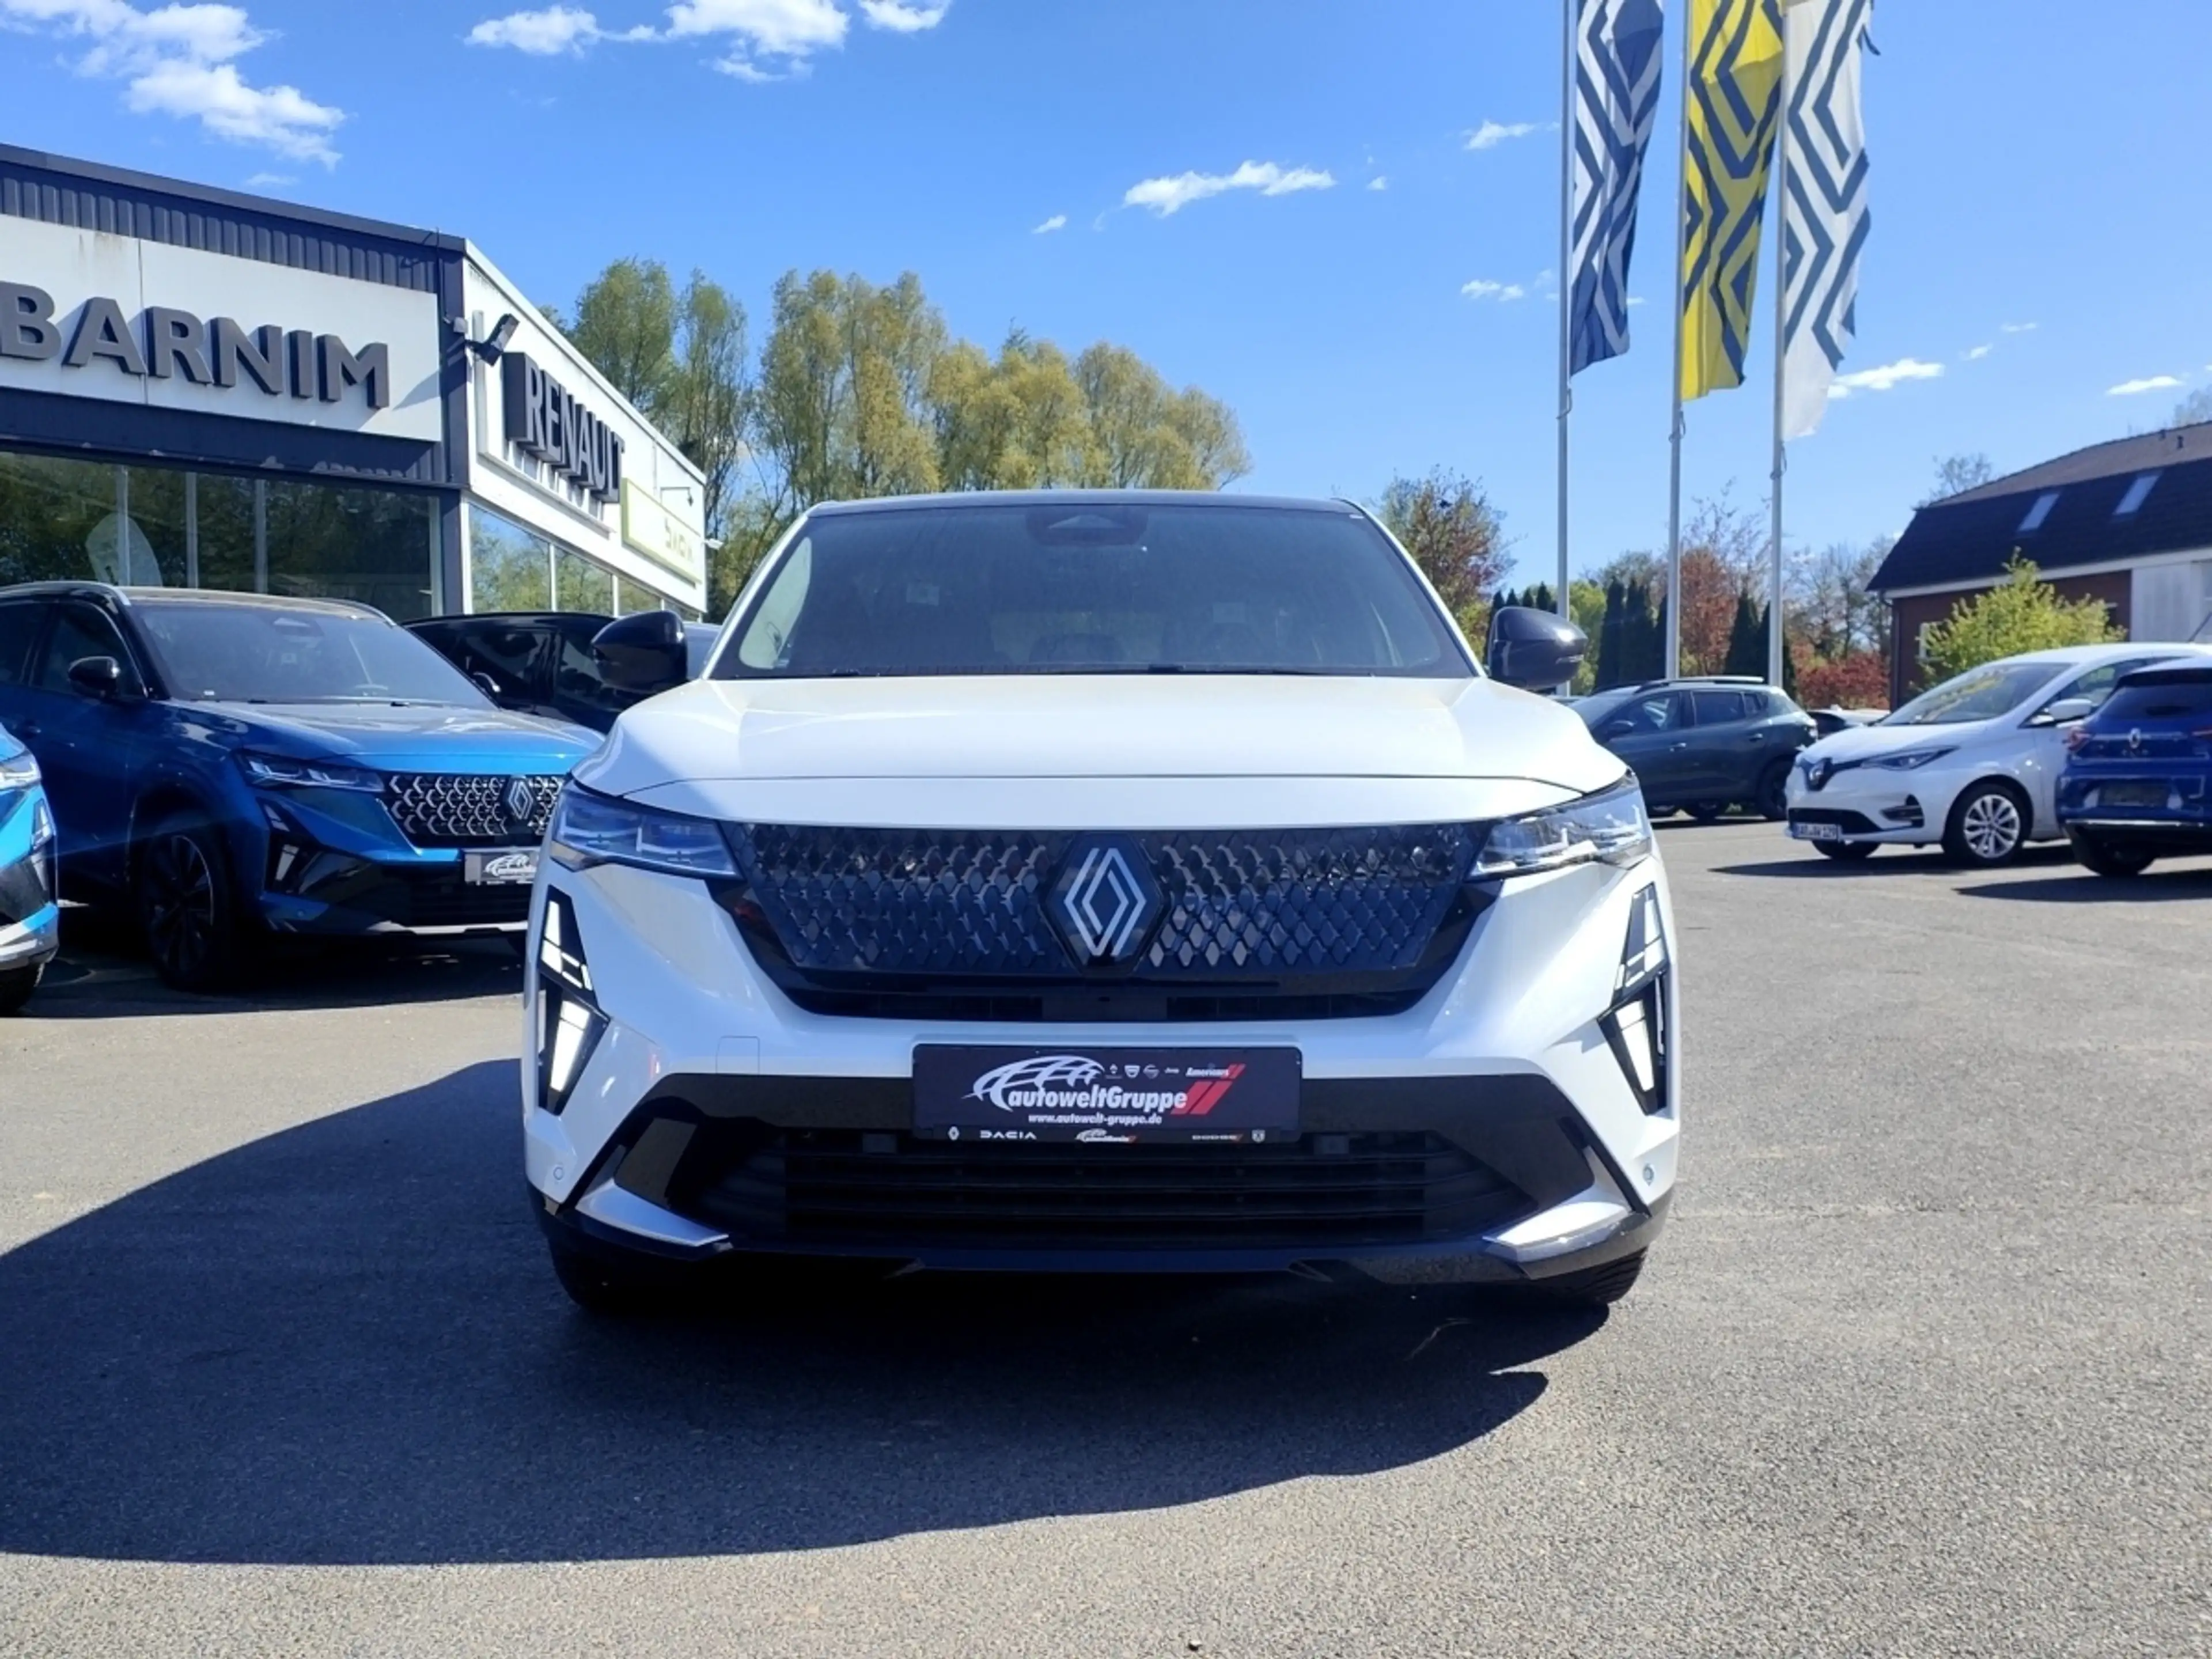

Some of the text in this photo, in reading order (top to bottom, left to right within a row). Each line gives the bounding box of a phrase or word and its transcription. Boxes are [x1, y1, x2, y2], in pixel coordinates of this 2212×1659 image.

[0, 281, 390, 409] BARNIM
[503, 351, 625, 503] RENAULT
[1007, 1084, 1188, 1113] autoweltGruppe
[1028, 1112, 1162, 1126] www.autowelt-gruppe.de
[979, 1130, 1037, 1140] DACIA
